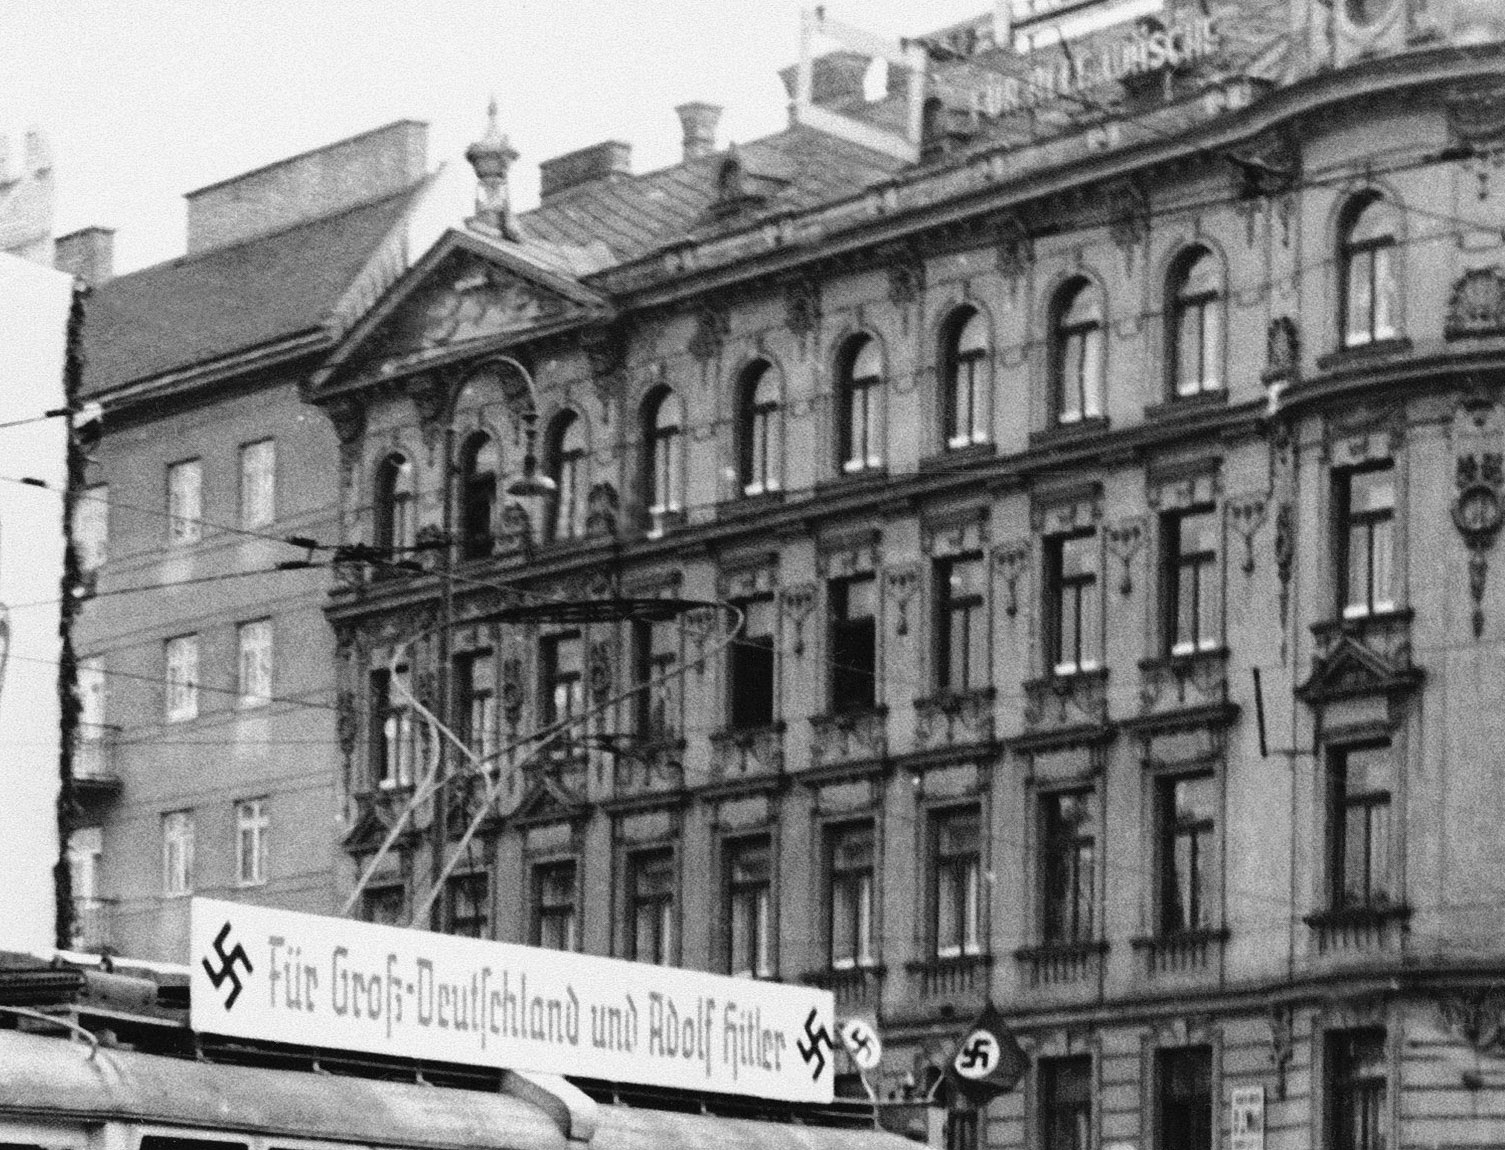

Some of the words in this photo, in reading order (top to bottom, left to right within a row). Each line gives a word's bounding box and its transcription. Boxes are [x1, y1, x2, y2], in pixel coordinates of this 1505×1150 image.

[269, 935, 319, 1012] Für
[591, 993, 639, 1053] und
[649, 990, 716, 1078] Adolf
[723, 1000, 787, 1081] Hitler
